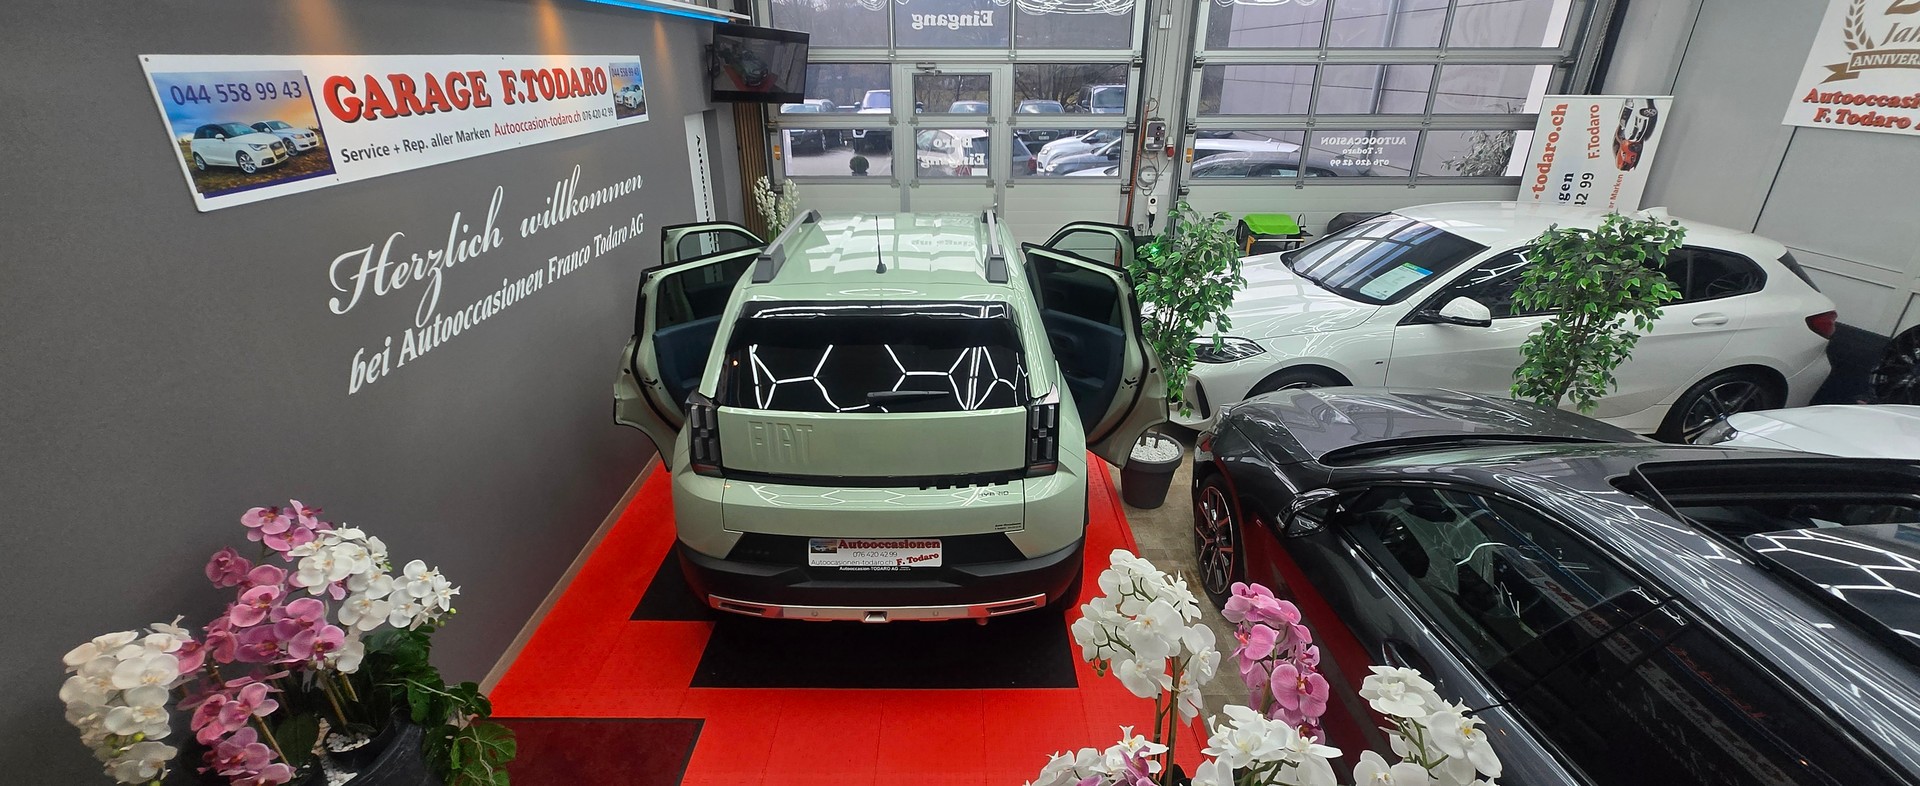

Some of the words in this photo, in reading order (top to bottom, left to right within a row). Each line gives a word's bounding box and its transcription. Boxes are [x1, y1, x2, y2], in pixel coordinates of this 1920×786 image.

[170, 84, 211, 106] 044
[216, 83, 252, 103] 558
[256, 82, 277, 101] 99
[282, 81, 302, 99] 43
[323, 70, 492, 124] GARAGE
[498, 66, 608, 105] F.TODARO
[1813, 107, 1832, 123] F.
[1835, 108, 1912, 129] Todaro
[340, 143, 390, 163] Service
[393, 143, 401, 154] +
[402, 139, 429, 154] Rep.
[431, 133, 454, 148] aller
[455, 127, 491, 144] Marken
[494, 110, 582, 137] Autooccasion-todaro.ch
[582, 110, 592, 121] 076
[592, 109, 601, 119] 420
[601, 108, 607, 118] 42
[607, 106, 614, 117] 99
[1579, 172, 1595, 189] 99
[1609, 174, 1624, 202] Marken
[328, 185, 504, 328] Herzlich
[520, 164, 644, 238] willkommen
[349, 335, 392, 395] bei
[396, 267, 544, 369] Autooccasionen
[547, 242, 591, 285] Franco
[593, 224, 628, 259] Todaro
[629, 213, 644, 236] AG
[747, 420, 813, 464] FIAT
[838, 539, 941, 549] Autooccasionen
[895, 558, 906, 566] F.
[906, 552, 940, 564] Todaro
